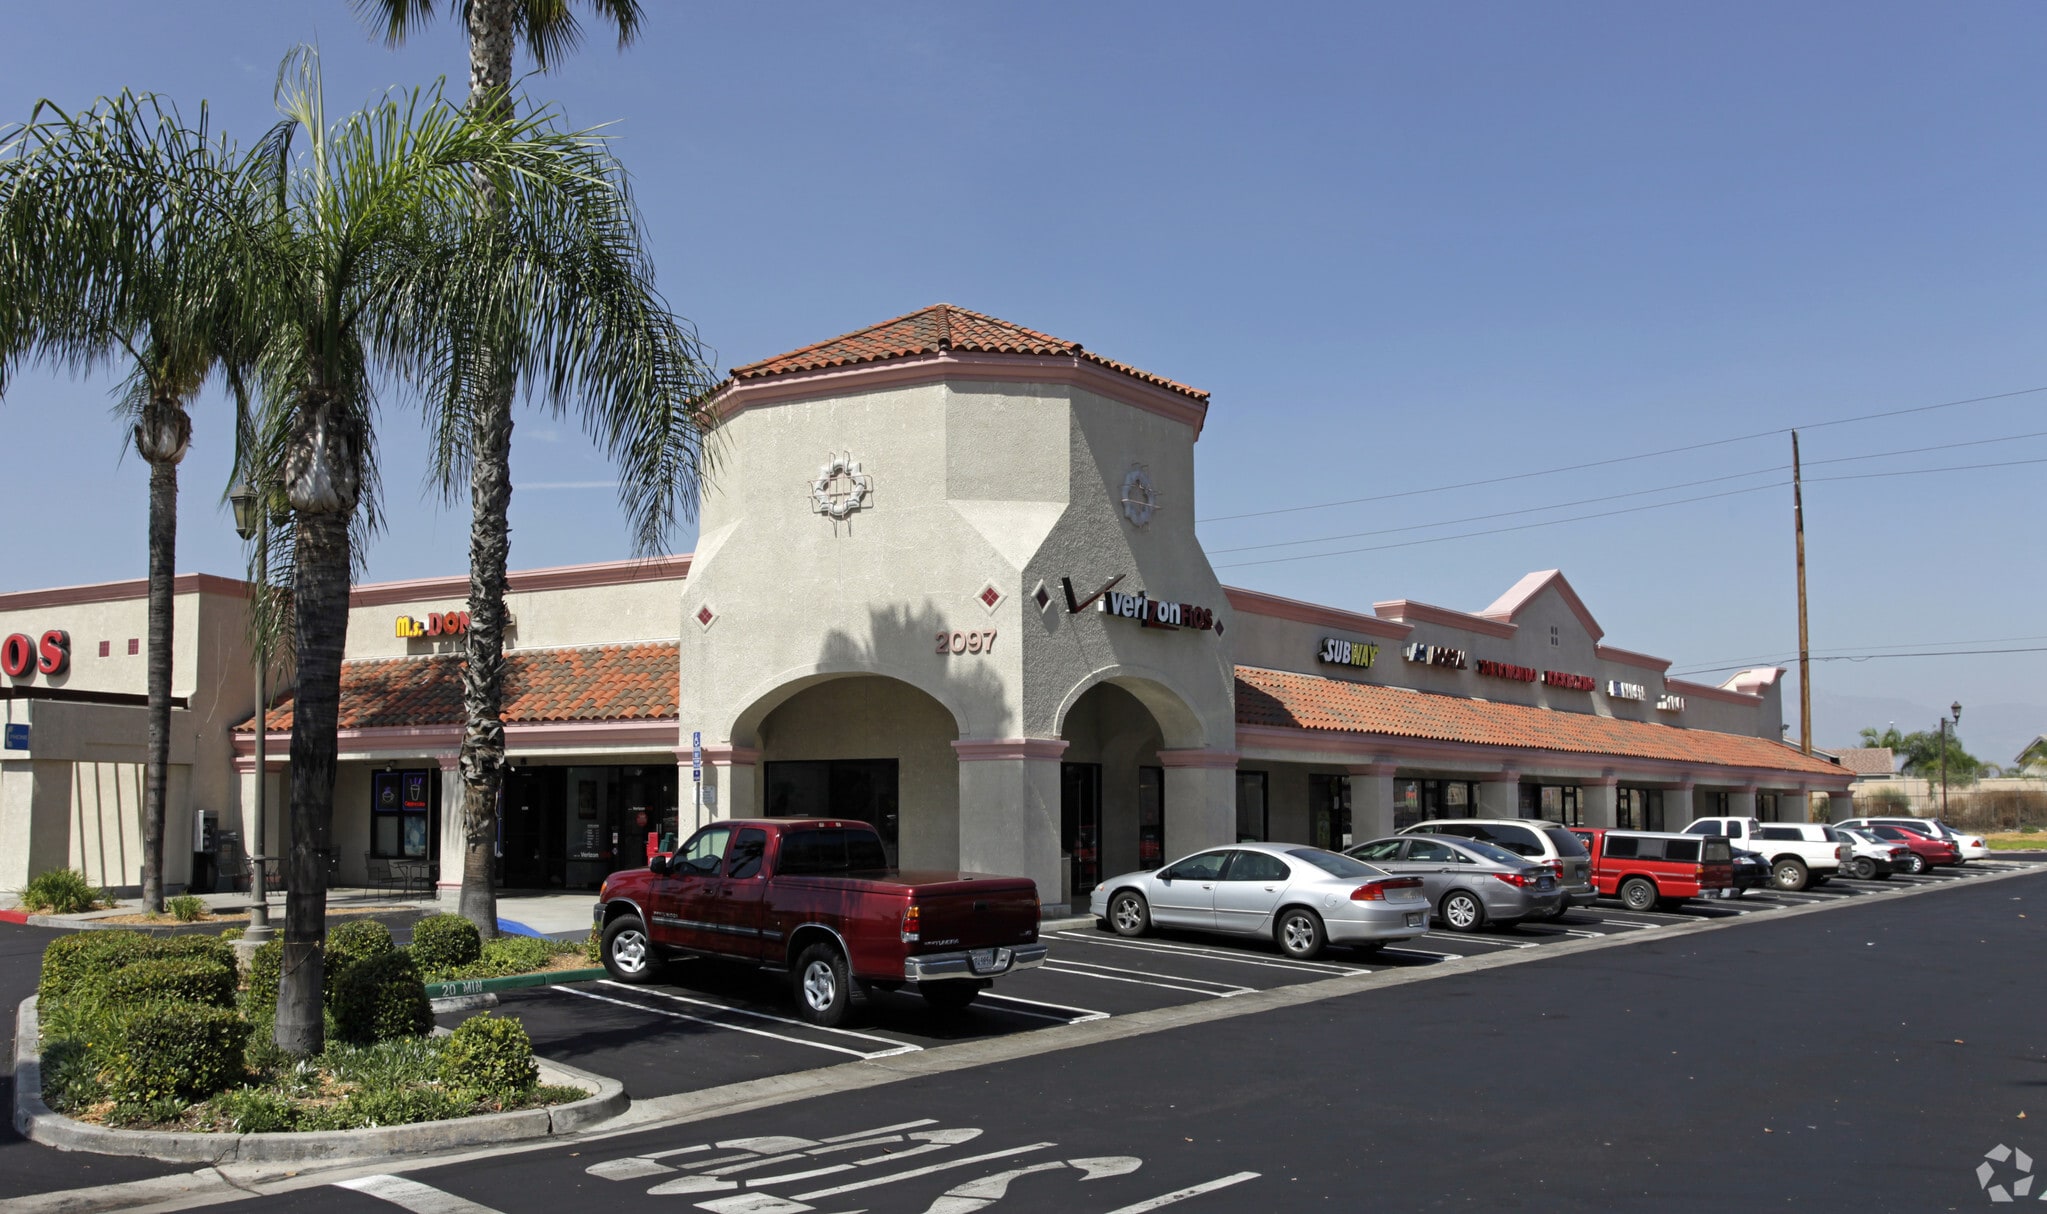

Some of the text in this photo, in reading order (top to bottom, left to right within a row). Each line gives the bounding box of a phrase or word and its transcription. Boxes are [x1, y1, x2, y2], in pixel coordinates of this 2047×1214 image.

[935, 629, 997, 655] 2097
[1320, 638, 1379, 668] SUBWAY
[441, 980, 483, 997] 20 MIN
